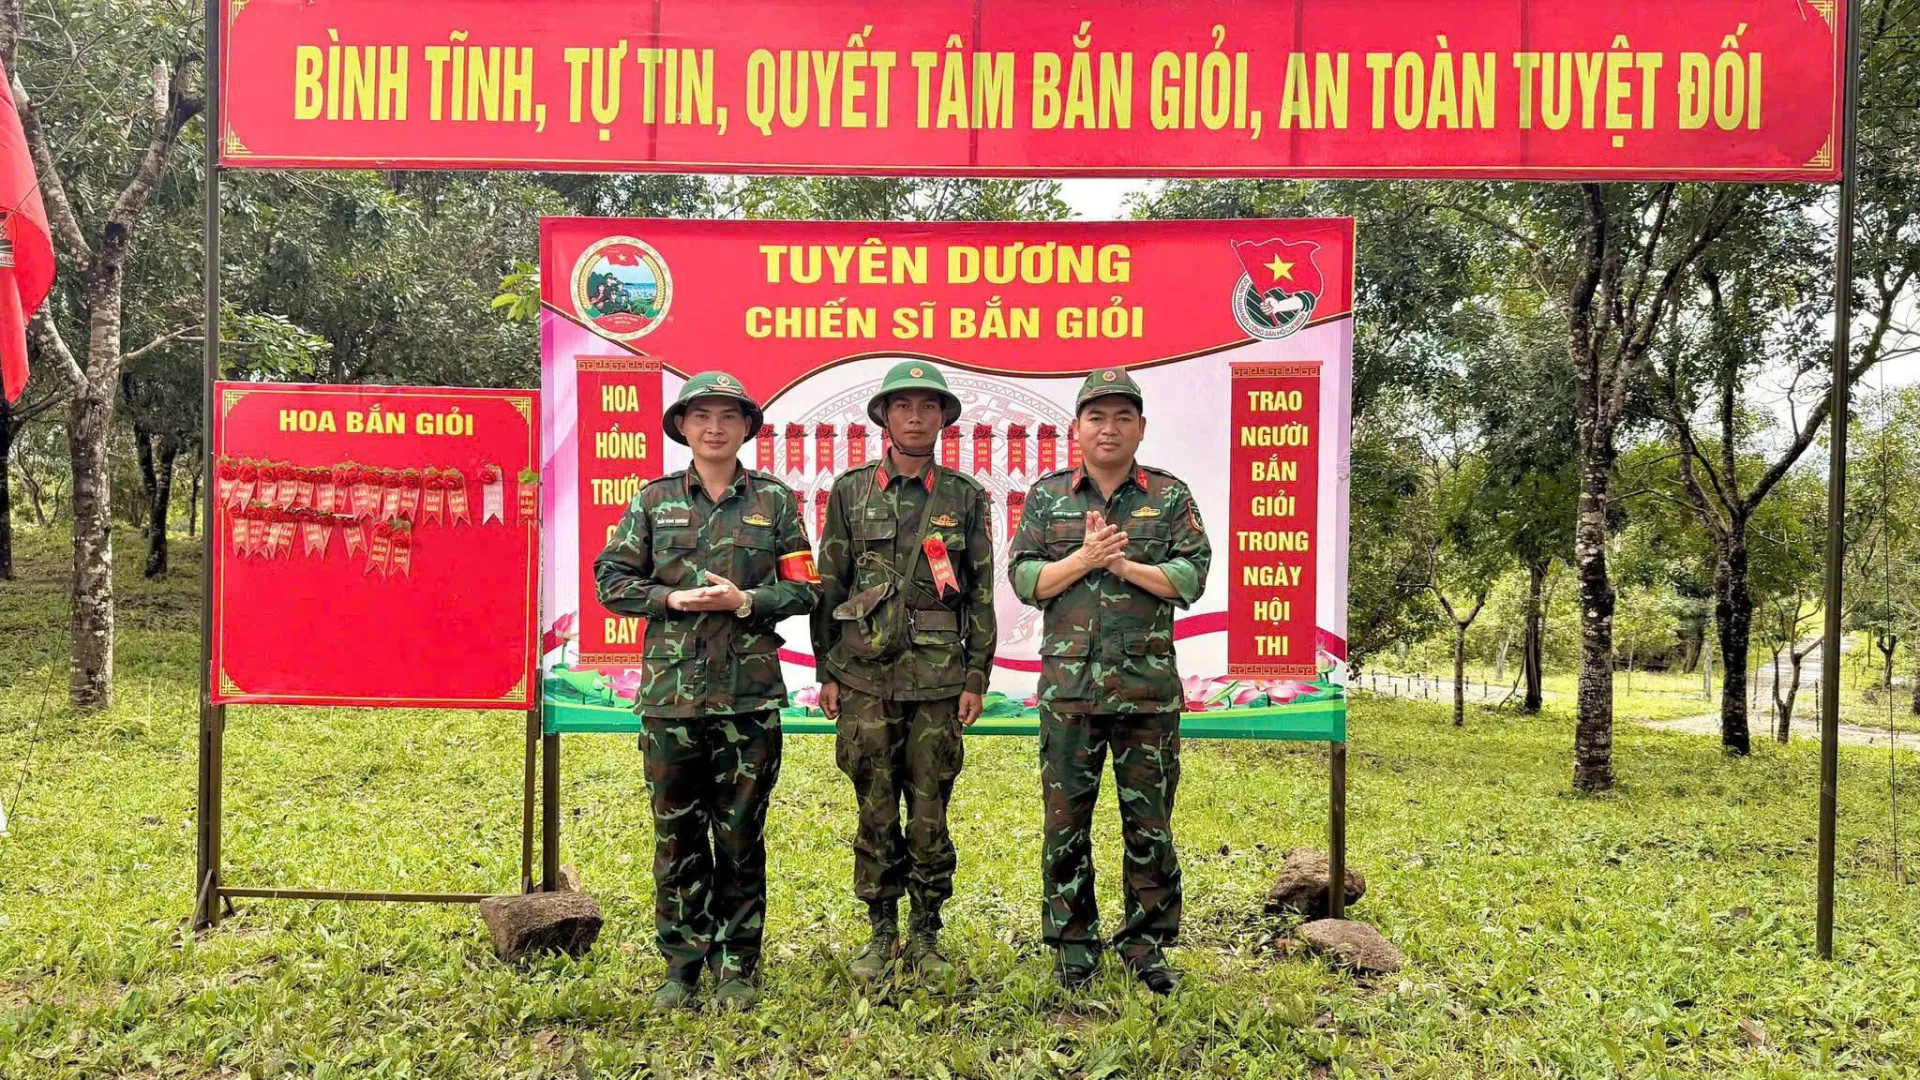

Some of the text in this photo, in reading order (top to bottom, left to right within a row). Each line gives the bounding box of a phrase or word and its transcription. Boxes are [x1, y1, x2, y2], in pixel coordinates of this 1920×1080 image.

[295, 22, 1761, 147] BÌNH TĨNH, TỰ TIN, QUYẾT TÂM BẮN GIỎI, AN TOÀN TUYỆT ĐỐI
[759, 238, 1130, 284] TUYÊN DƯƠNG
[746, 296, 1143, 339] CHIẾN SĨ BẮN GIỎI
[602, 385, 639, 412] HOA
[1248, 391, 1302, 411] TRAO
[280, 403, 473, 435] HOA BẮN GIỎI
[596, 423, 646, 458] HỒNG
[1241, 421, 1308, 446] NGƯỜI
[1252, 454, 1296, 481] BẮN
[1252, 490, 1295, 516] GIỎI
[1237, 531, 1308, 551] TRONG
[1244, 562, 1301, 586] NGÀY
[1254, 597, 1289, 625] HỘI
[605, 618, 639, 644] BAY
[1255, 636, 1288, 655] THI
